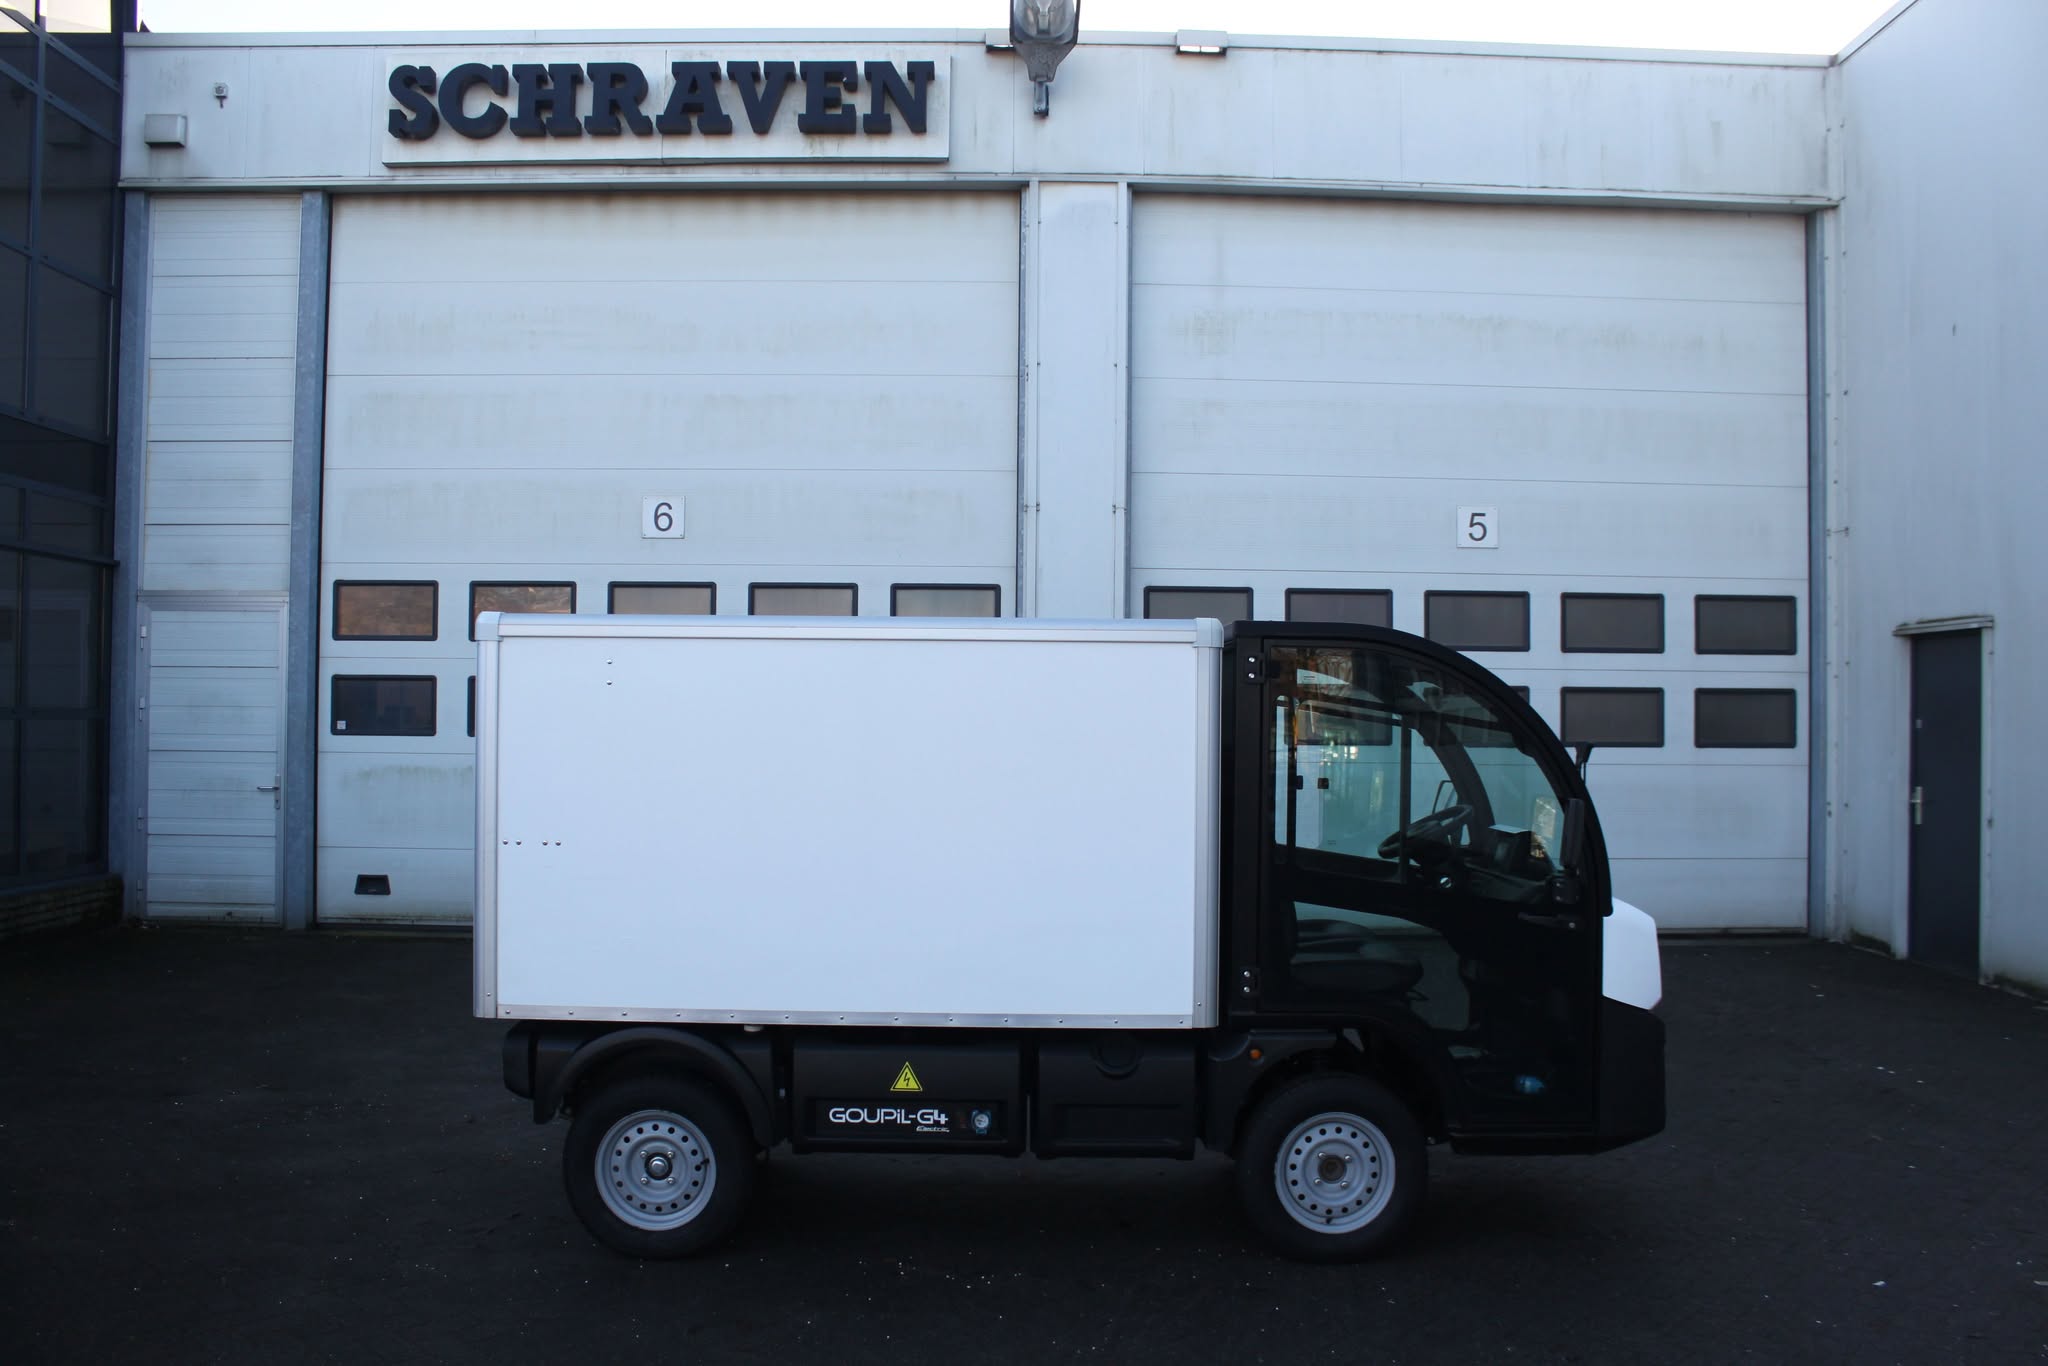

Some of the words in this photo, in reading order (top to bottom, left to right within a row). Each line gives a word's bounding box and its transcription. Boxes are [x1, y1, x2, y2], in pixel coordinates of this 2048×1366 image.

[388, 60, 935, 140] SCHRAVEN
[653, 501, 673, 532] 6
[1468, 512, 1487, 541] 5
